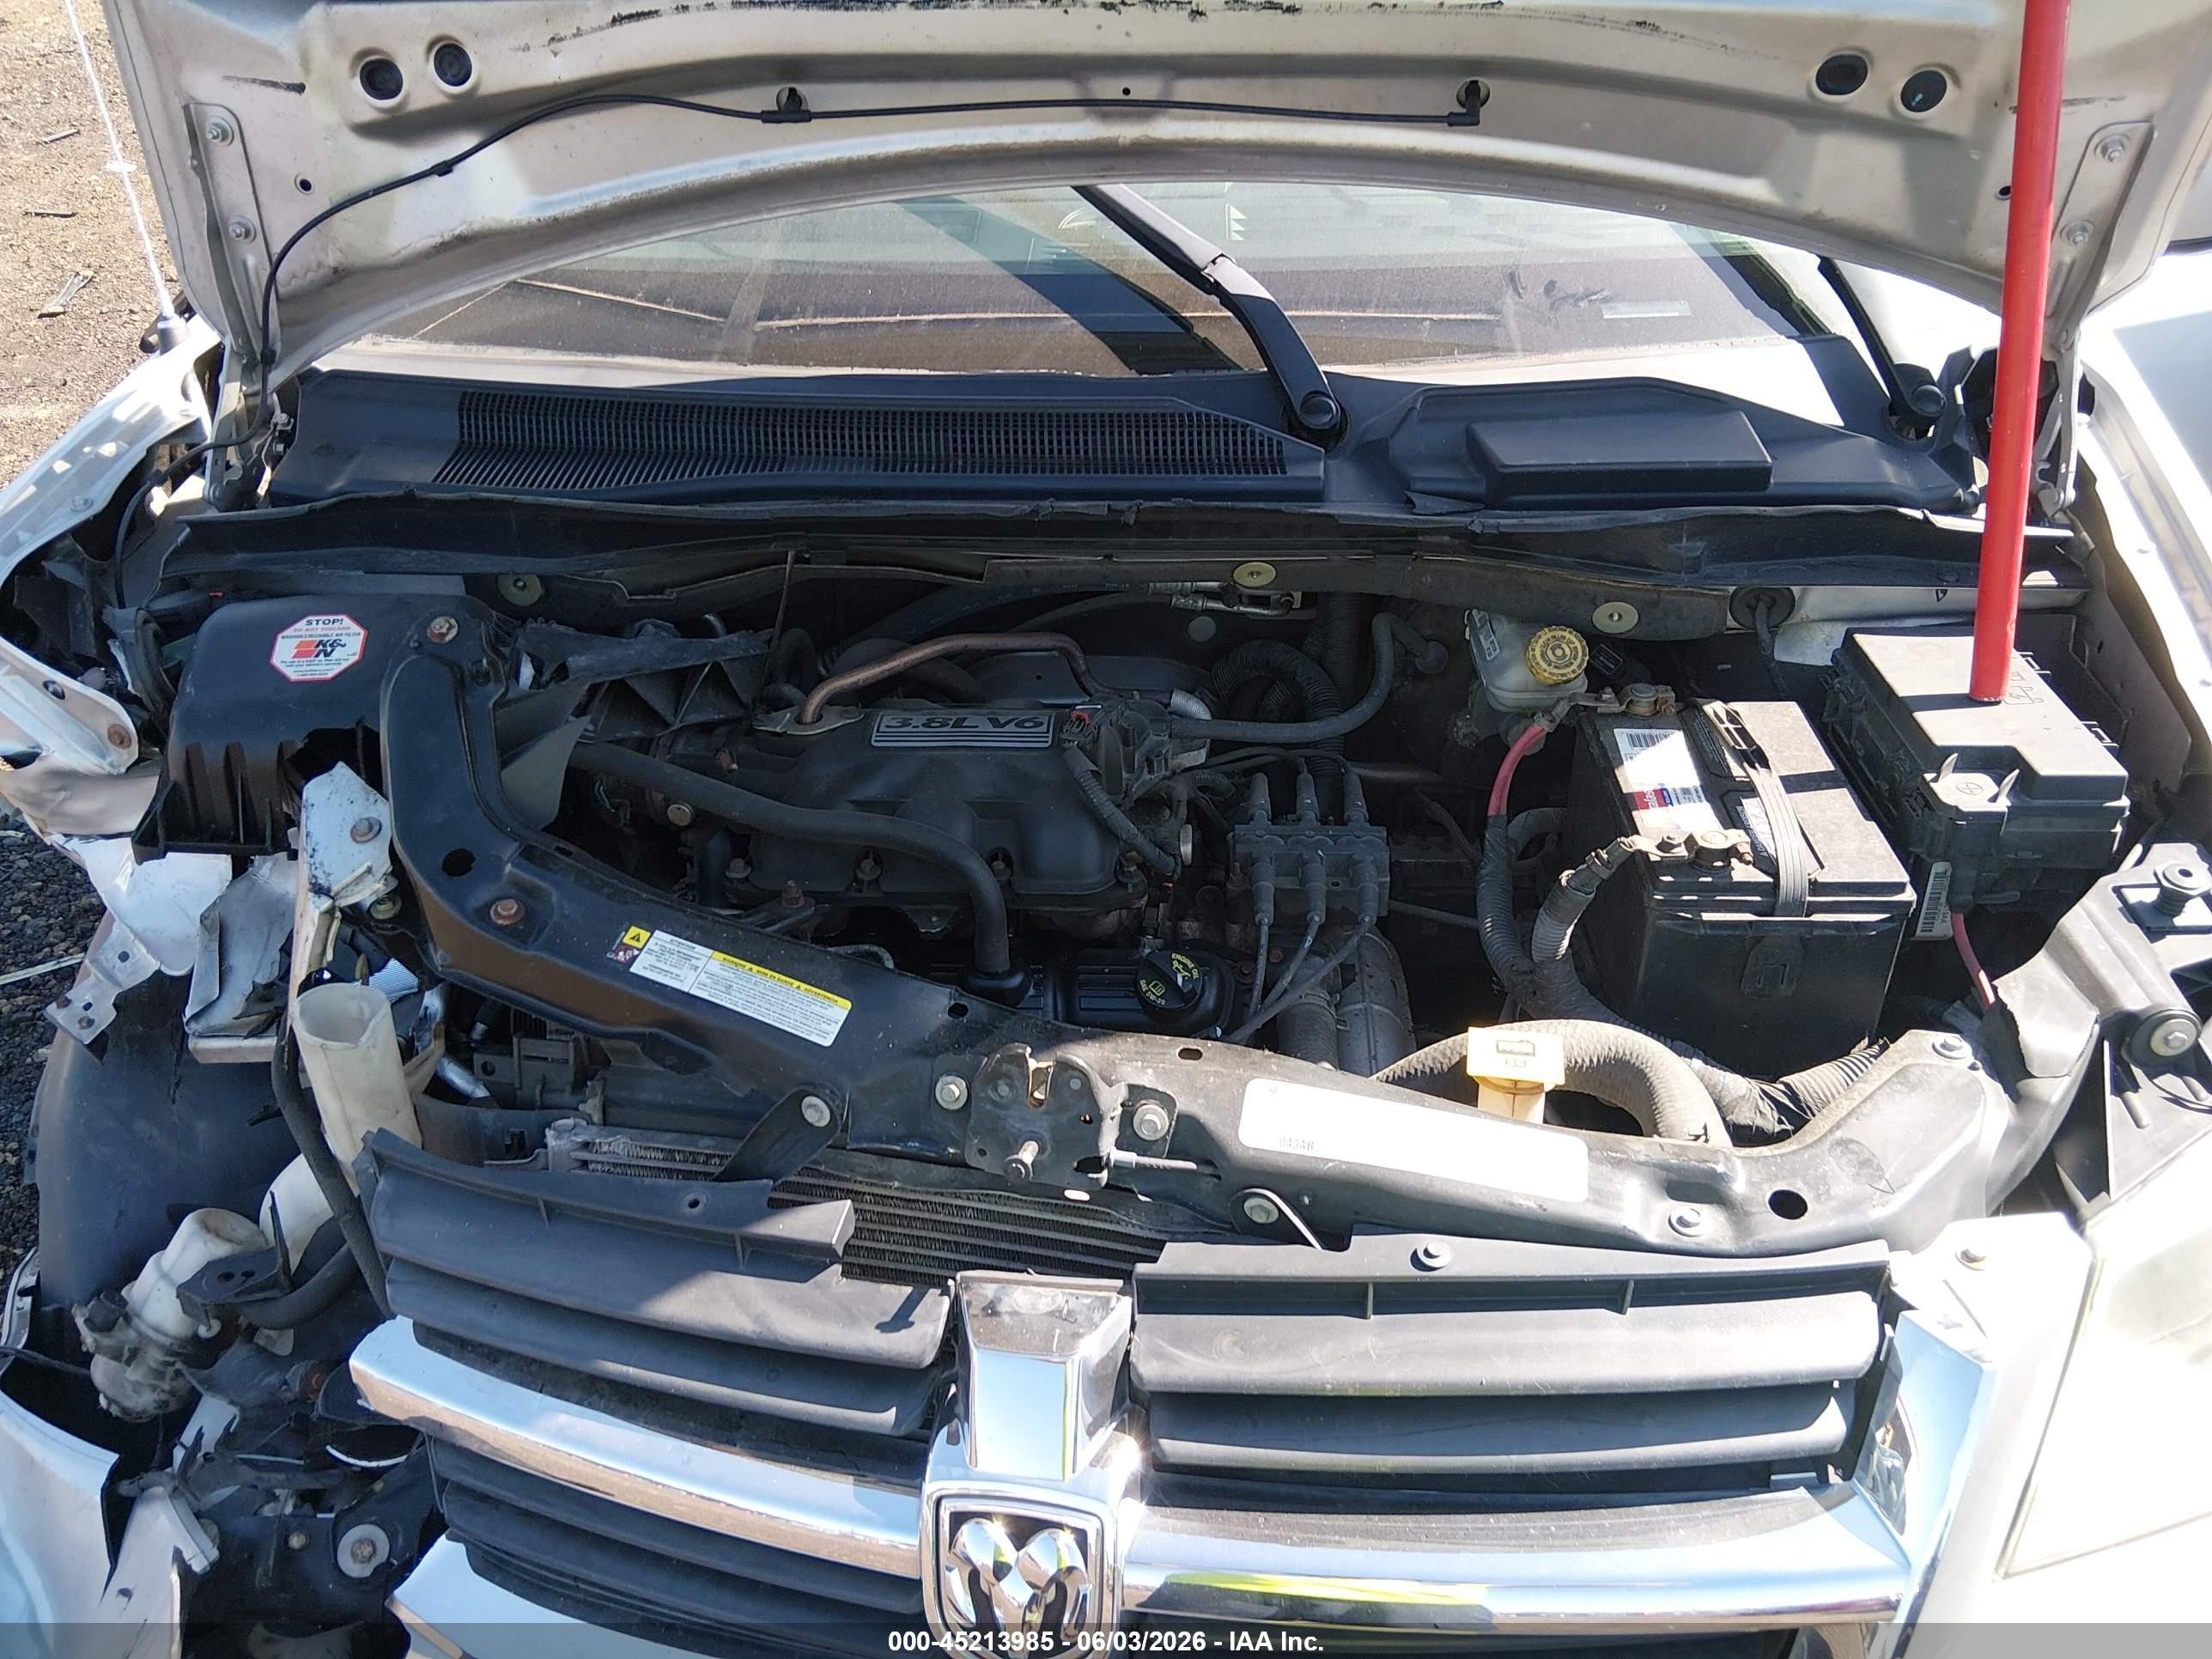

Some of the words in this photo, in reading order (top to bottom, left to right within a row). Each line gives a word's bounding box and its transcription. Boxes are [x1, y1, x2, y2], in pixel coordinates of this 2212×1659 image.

[885, 716, 979, 729] 3.8L
[988, 716, 1045, 729] V6
[1171, 952, 1195, 969] ENGINE
[1191, 968, 1200, 980] OIL
